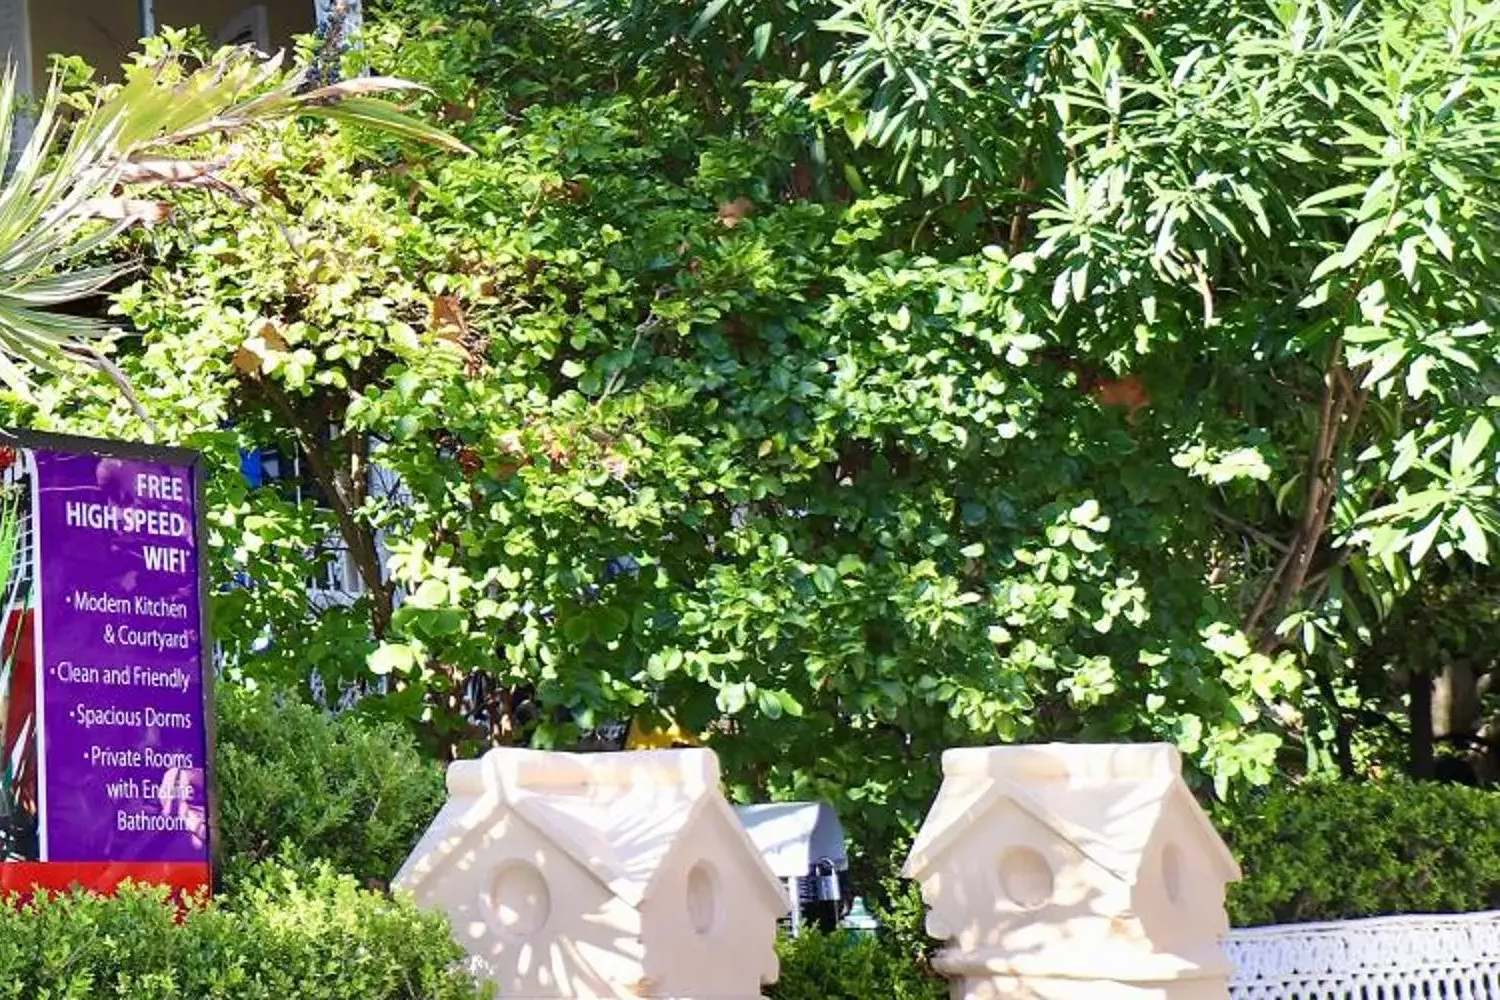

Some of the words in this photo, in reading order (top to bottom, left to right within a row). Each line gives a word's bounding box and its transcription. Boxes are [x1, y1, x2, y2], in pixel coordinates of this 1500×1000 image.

[136, 473, 184, 501] FREE
[66, 501, 118, 531] HIGH
[123, 507, 185, 537] SPEED
[143, 545, 187, 573] WIFI
[74, 590, 131, 614] Modern
[135, 596, 187, 619] Kitchen
[103, 623, 115, 644] &
[117, 625, 189, 652] Courtyard
[57, 661, 99, 683] Clean
[103, 665, 131, 685] and
[133, 666, 190, 693] Friendly
[77, 703, 141, 728] Spacious
[145, 707, 192, 728] Dorms
[92, 746, 141, 767] Private
[145, 748, 193, 768] Rooms
[106, 778, 139, 799] with
